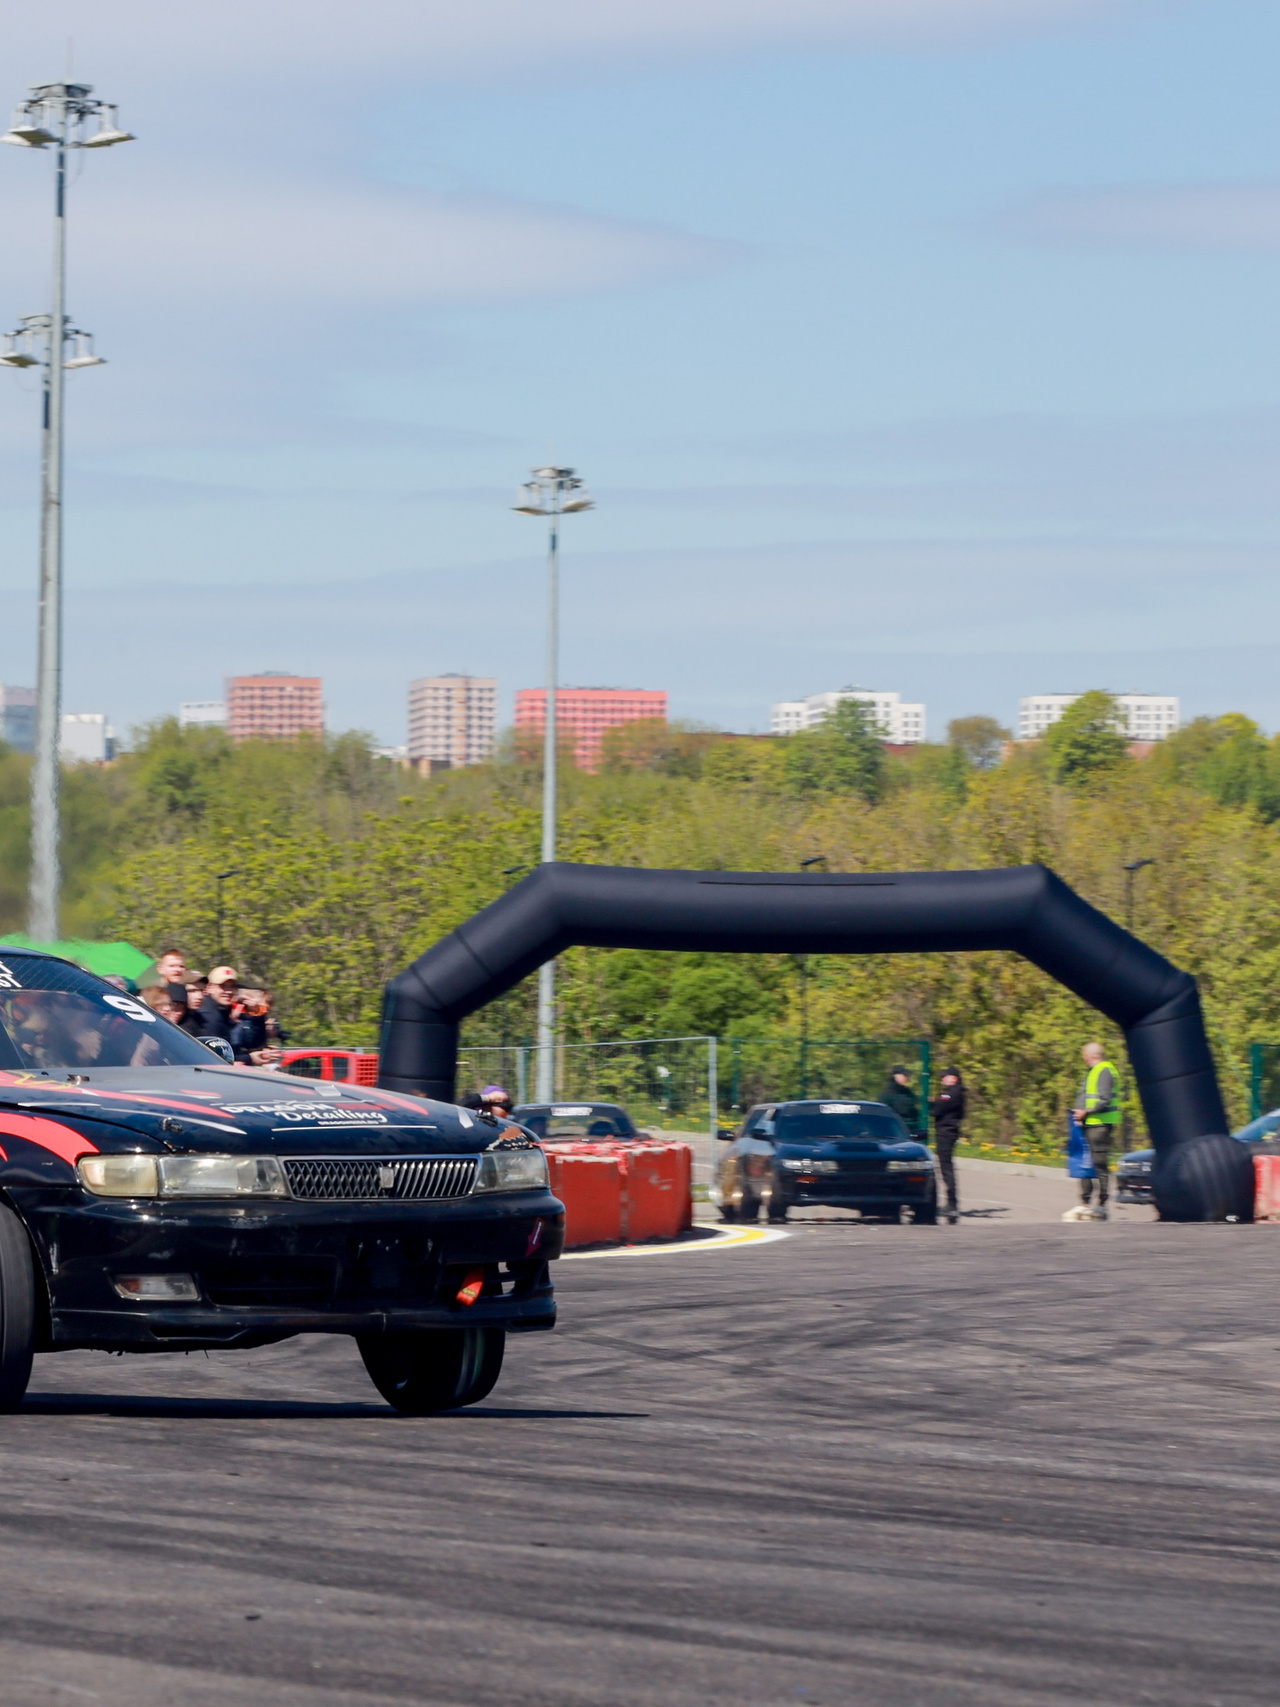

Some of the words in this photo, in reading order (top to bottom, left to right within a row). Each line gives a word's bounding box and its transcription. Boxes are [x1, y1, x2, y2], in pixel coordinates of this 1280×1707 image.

[102, 995, 157, 1023] 9
[220, 1101, 337, 1114] DRAGON
[275, 1108, 388, 1124] Detailing
